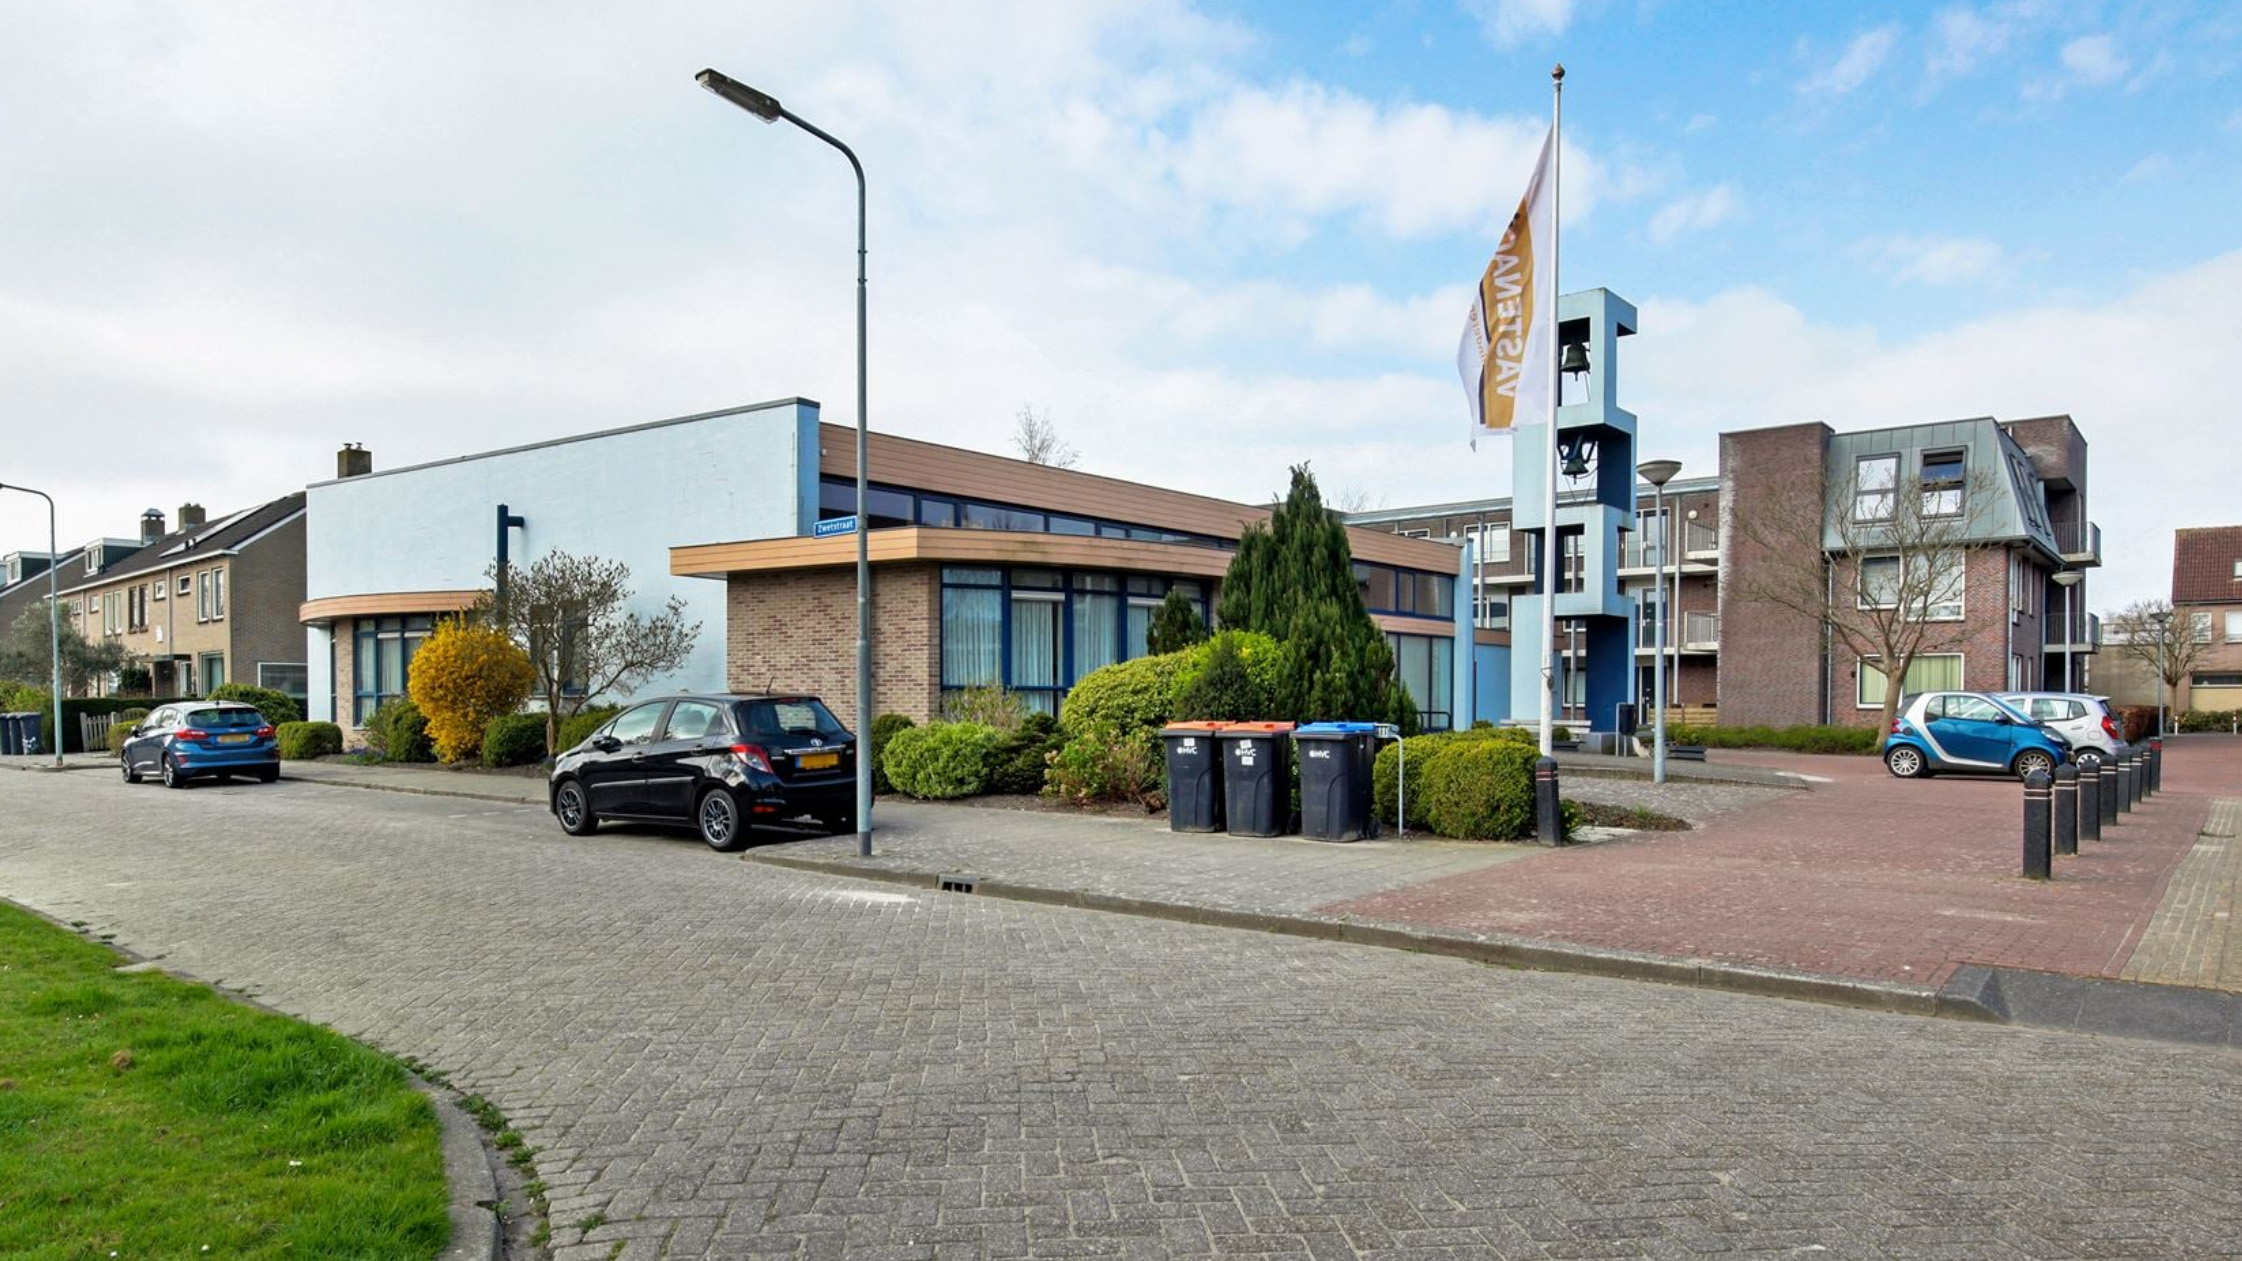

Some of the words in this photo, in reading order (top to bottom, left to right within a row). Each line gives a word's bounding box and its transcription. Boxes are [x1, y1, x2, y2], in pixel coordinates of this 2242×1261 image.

[1182, 746, 1198, 755] HVC
[1241, 748, 1257, 757] HVC
[1315, 750, 1330, 759] HVC
